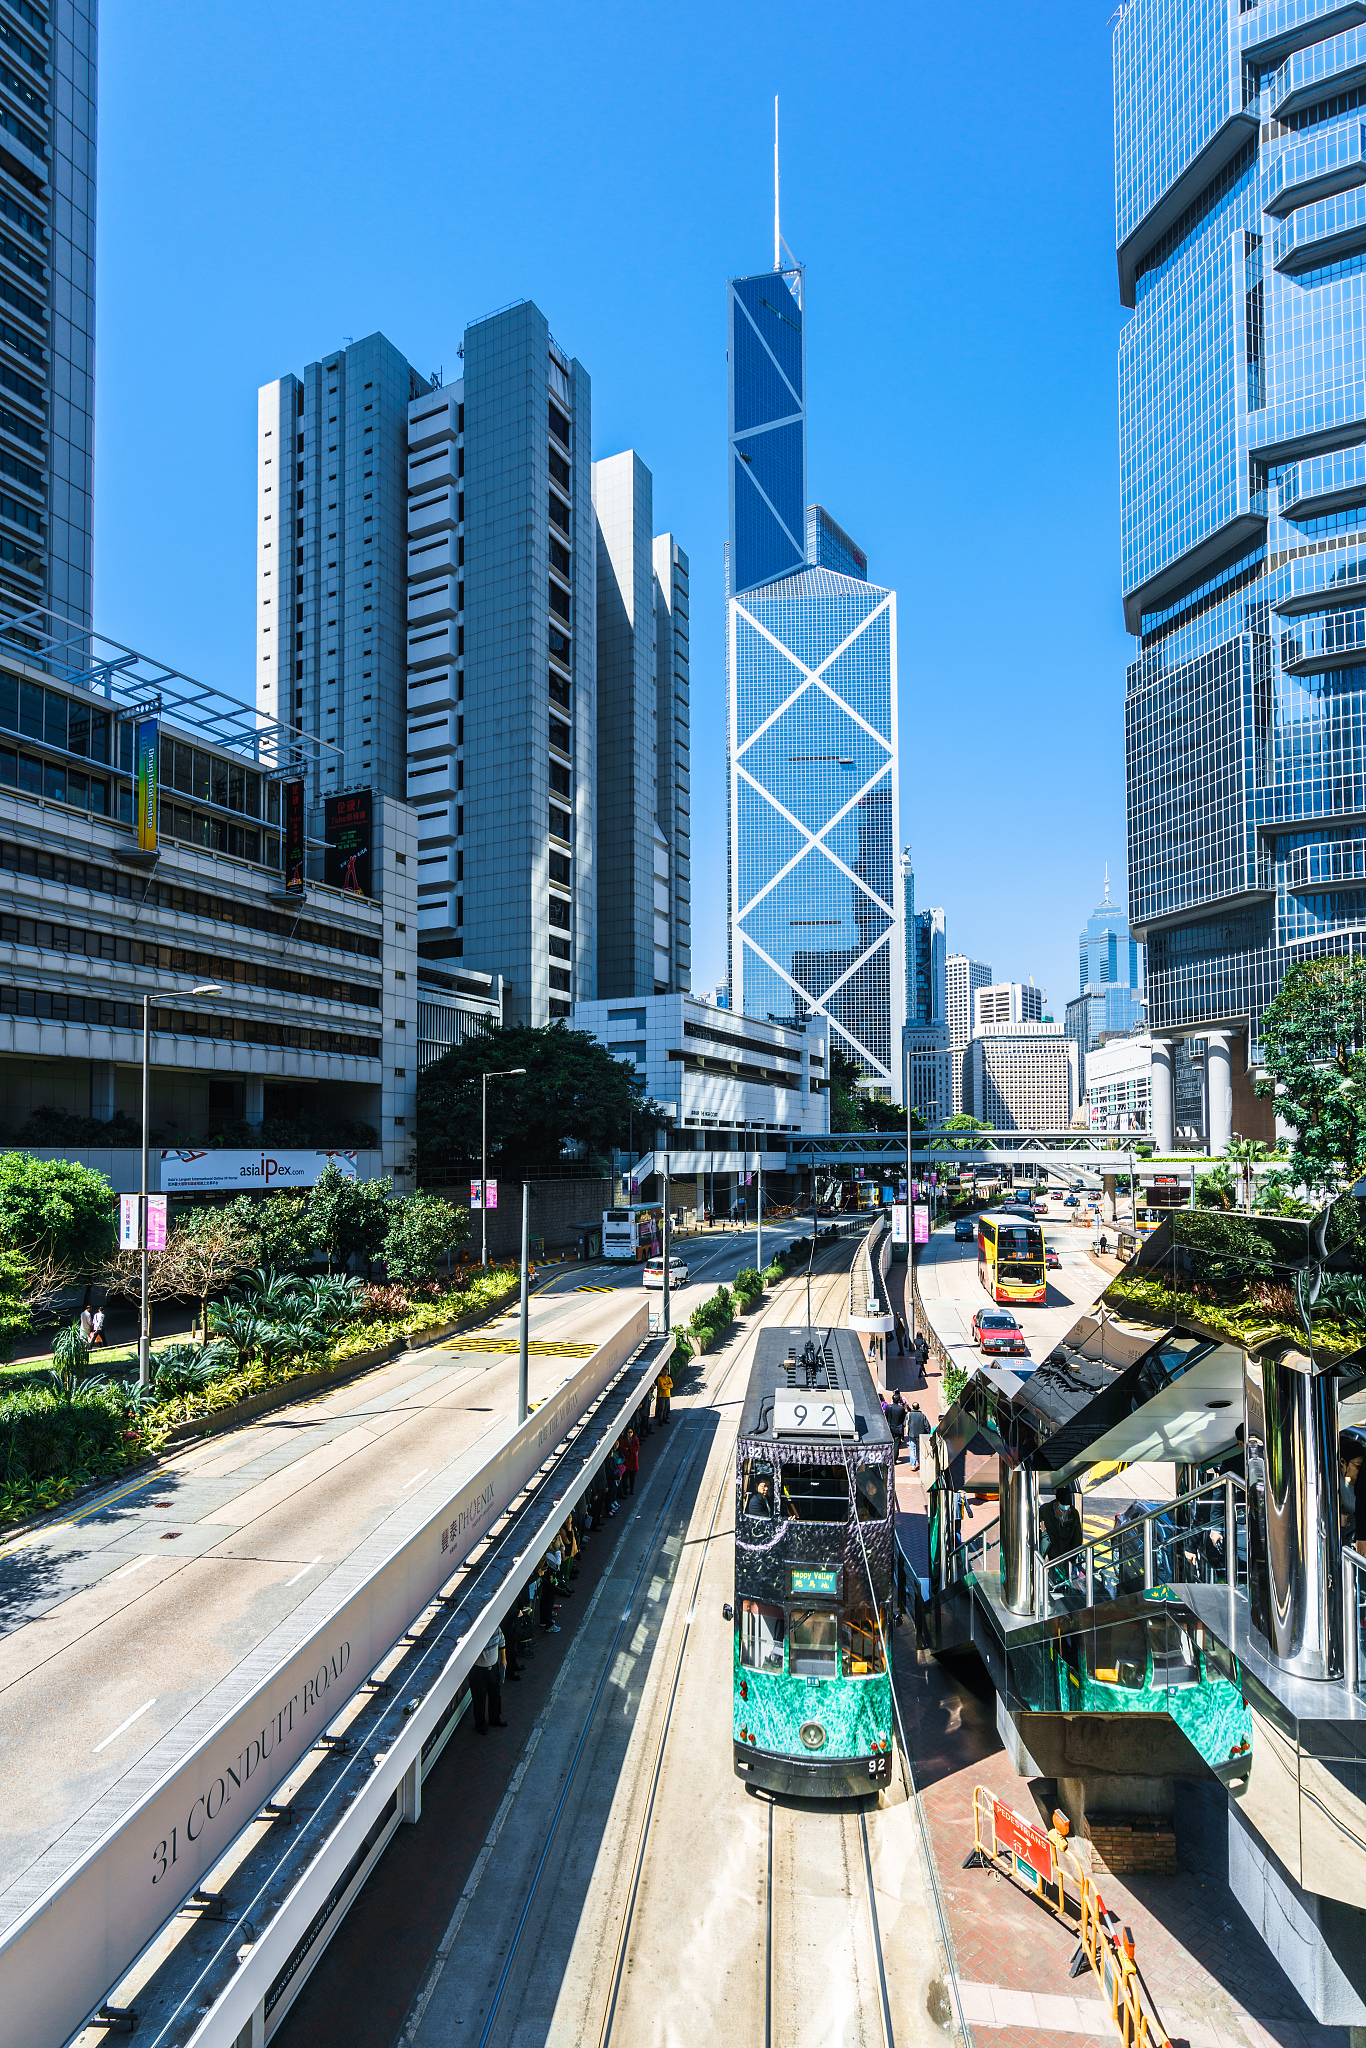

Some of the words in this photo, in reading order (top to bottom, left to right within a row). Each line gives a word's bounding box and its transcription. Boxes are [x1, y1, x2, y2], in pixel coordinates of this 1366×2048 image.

[147, 774, 155, 828] InfoCentre
[748, 1447, 762, 1459] 92
[868, 1452, 882, 1464] 92
[458, 1480, 495, 1535] PHOENIX
[791, 1570, 811, 1580] Happy
[814, 1572, 834, 1581] Valley
[152, 1827, 180, 1884] 31
[187, 1695, 298, 1841] CONDUIT
[302, 1641, 350, 1716] ROAD
[869, 1758, 886, 1773] 92
[996, 1805, 1047, 1850] PEDESTRIANS
[1013, 1840, 1033, 1863] 行人
